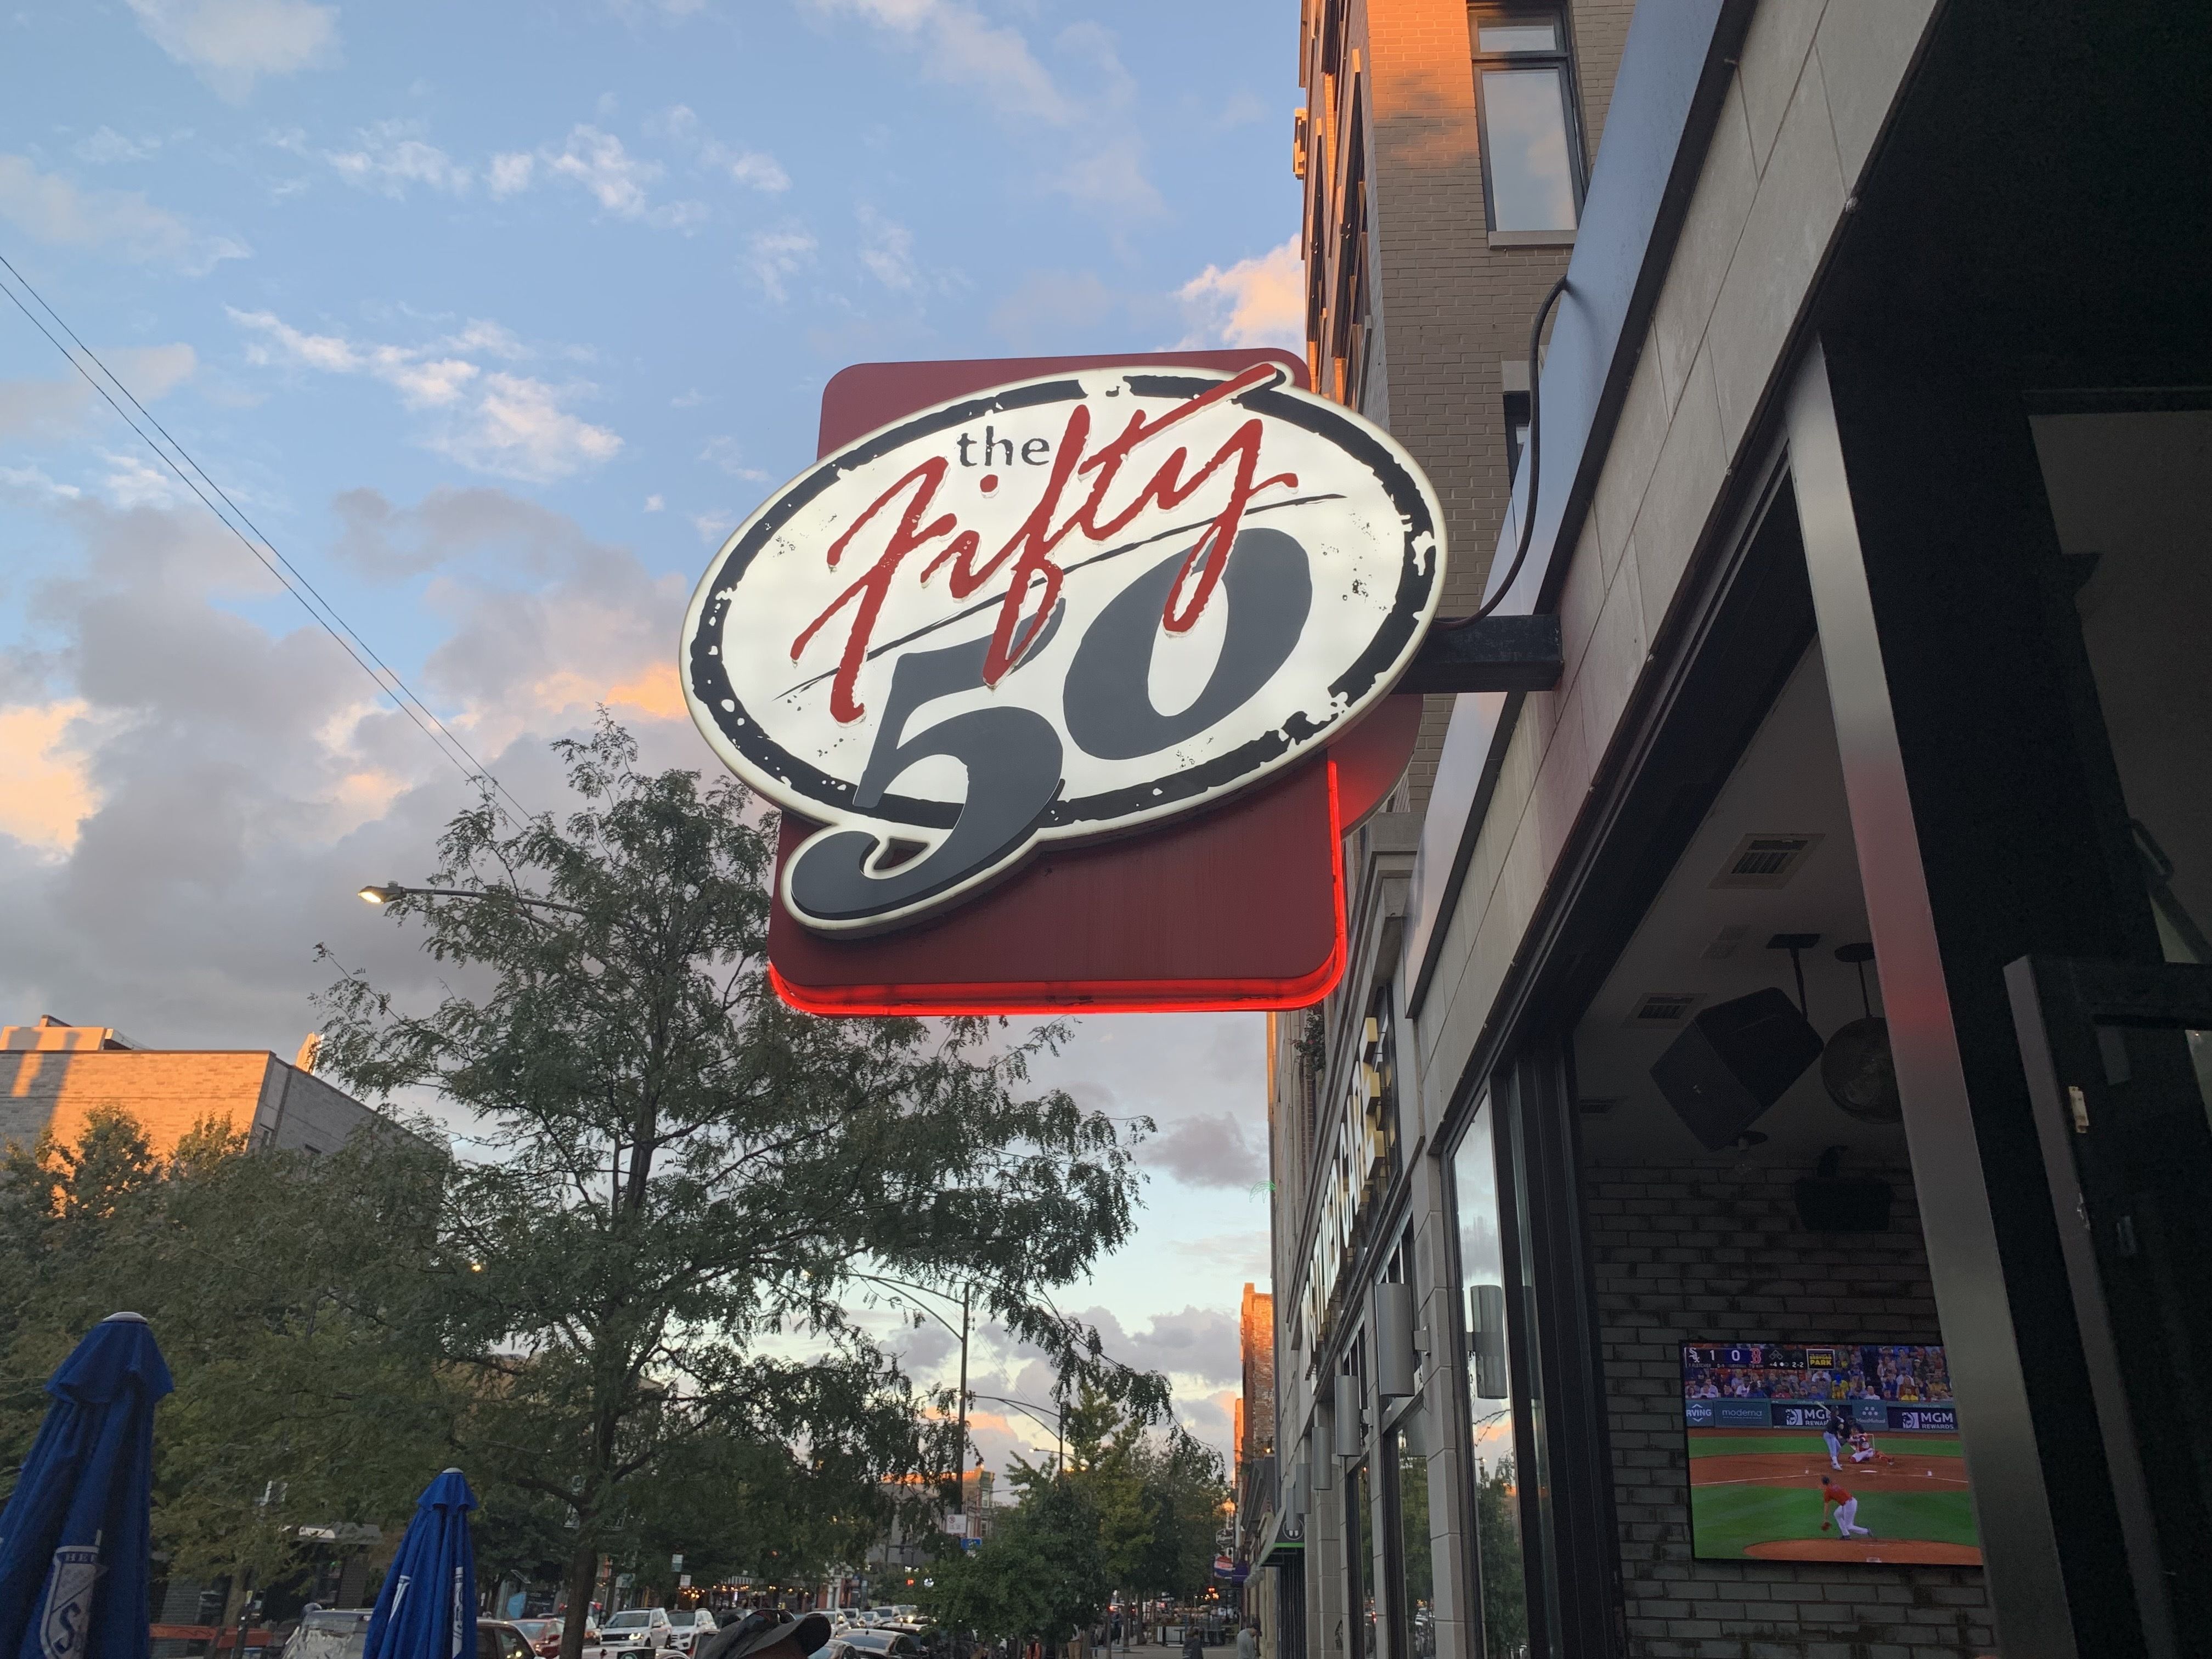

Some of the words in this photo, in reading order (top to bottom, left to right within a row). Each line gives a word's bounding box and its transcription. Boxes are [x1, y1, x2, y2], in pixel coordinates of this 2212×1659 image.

[956, 425, 1050, 467] the
[789, 362, 1299, 724] Fifty
[791, 527, 1313, 920] 50
[1709, 1350, 1715, 1361] 1
[1731, 1350, 1740, 1361] 0
[1921, 1413, 1954, 1423] MGM
